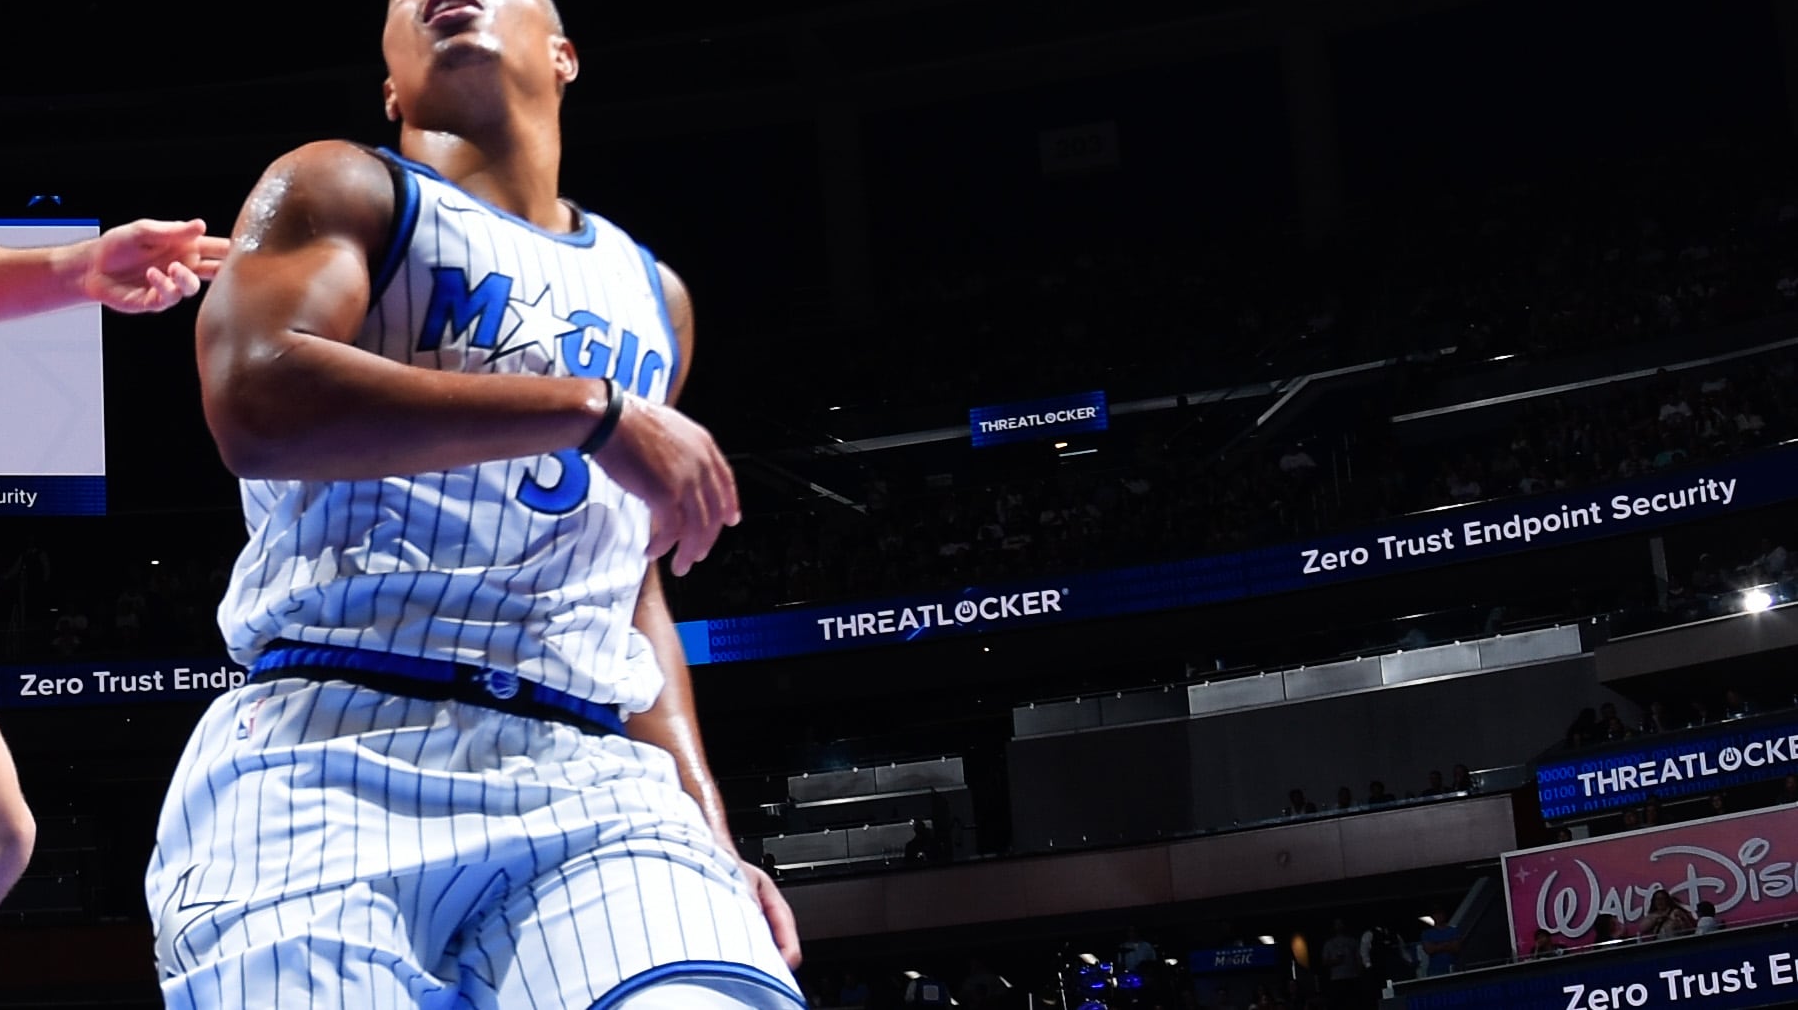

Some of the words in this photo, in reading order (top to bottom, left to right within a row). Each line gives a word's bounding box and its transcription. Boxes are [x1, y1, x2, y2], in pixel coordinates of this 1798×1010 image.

[979, 406, 1096, 433] THREATLOCKER
[817, 589, 1062, 641] THREATLOCKER
[1300, 546, 1369, 575] Zero
[1377, 528, 1455, 561] Trust
[1463, 502, 1602, 547] Endpoint
[1610, 478, 1737, 521] Security
[19, 674, 84, 696] Zero
[93, 670, 164, 692] Trust
[1562, 983, 1648, 1010] Zero
[1659, 961, 1758, 1001] Trust
